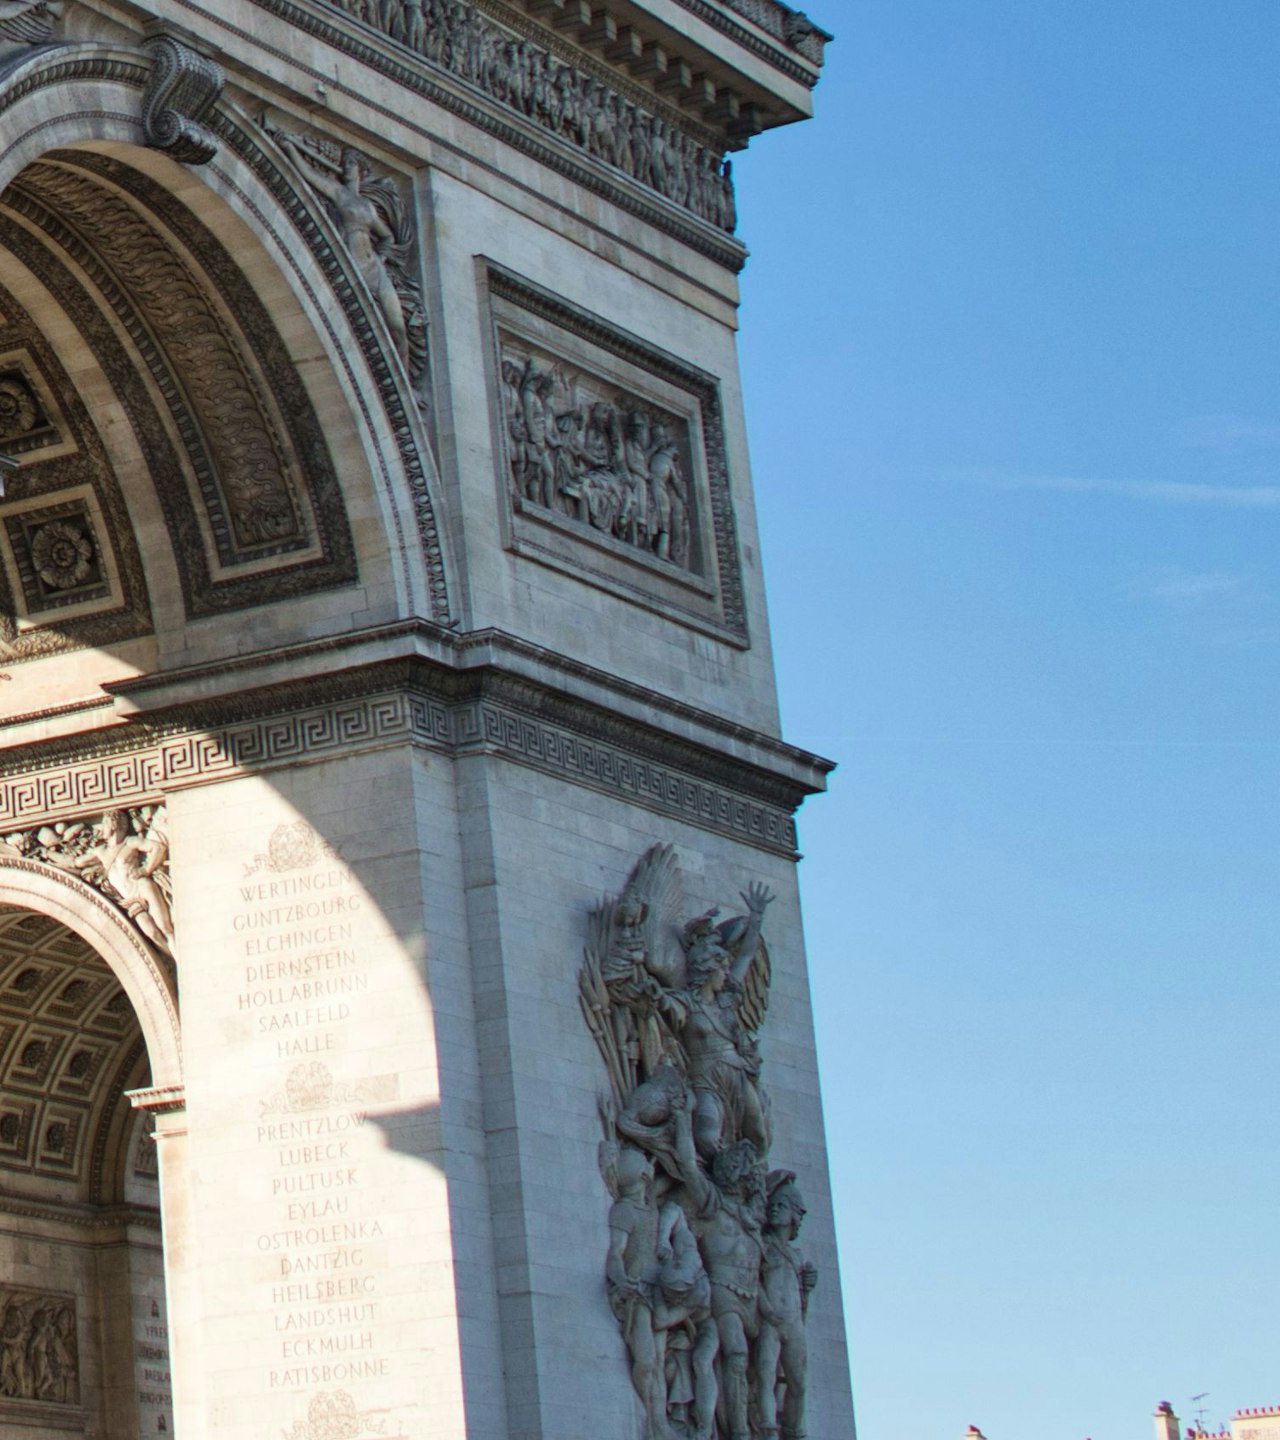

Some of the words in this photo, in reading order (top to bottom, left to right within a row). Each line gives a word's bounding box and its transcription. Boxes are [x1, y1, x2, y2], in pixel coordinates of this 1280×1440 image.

[240, 870, 354, 903] WERTINGEN
[232, 895, 361, 931] GUNTZBOURG
[246, 923, 352, 956] ELCHINGEN
[246, 950, 356, 982] DIERNSTEIN
[238, 975, 368, 1010] HOLLABRUNN
[259, 1004, 349, 1032] SAALFELD
[278, 1033, 335, 1057] HALLE
[258, 1111, 367, 1143] PRENTZLOW
[280, 1142, 351, 1166] LUBECK
[273, 1169, 359, 1195] PULTUSK
[288, 1197, 348, 1221] EYLAU
[258, 1221, 383, 1251] OSTROLENKA
[281, 1249, 363, 1275] DANTZIG
[273, 1276, 376, 1303] HEILSBERG
[275, 1304, 377, 1331] LANDSHUT
[283, 1333, 372, 1358] ECKMULH
[145, 1369, 171, 1382] BRESLA
[270, 1360, 390, 1387] RATISBONNE
